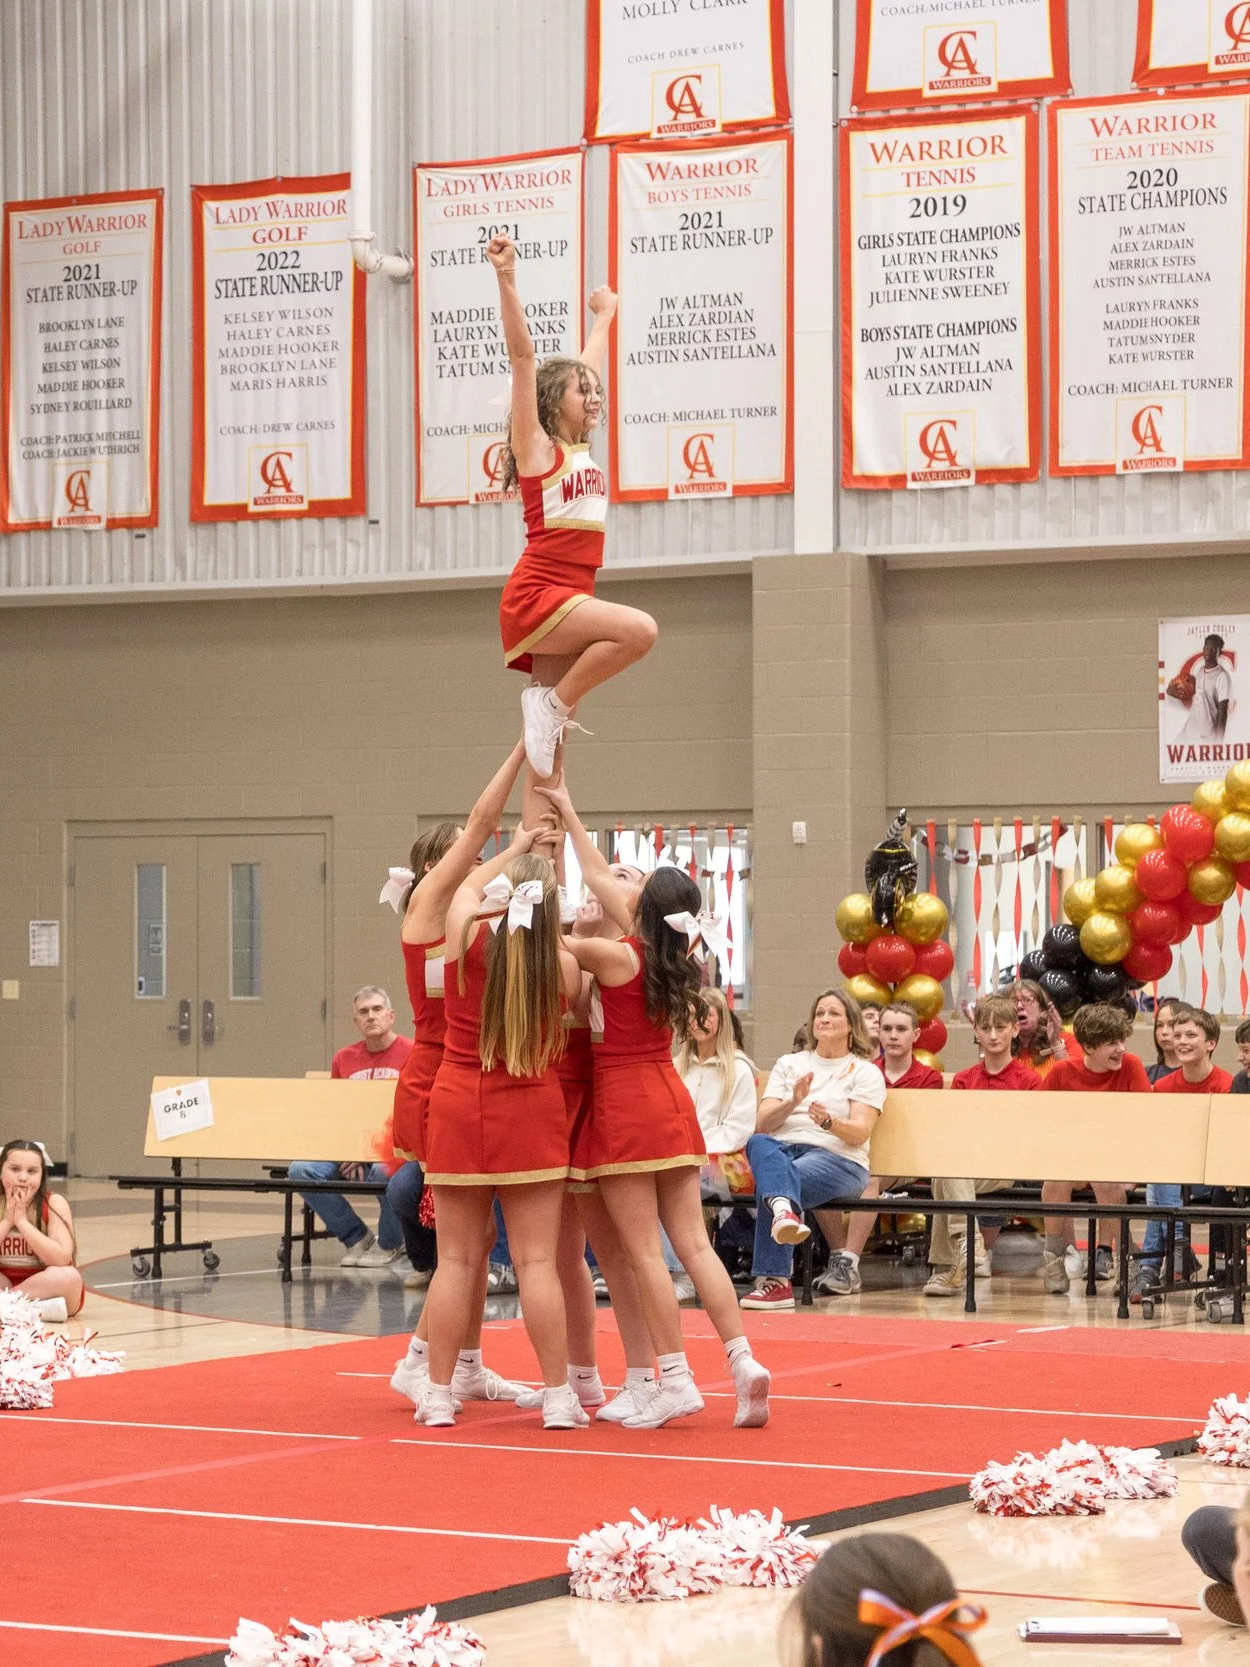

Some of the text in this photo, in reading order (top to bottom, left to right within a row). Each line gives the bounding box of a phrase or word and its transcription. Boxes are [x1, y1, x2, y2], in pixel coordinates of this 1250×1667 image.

[622, 0, 680, 20] MOLLY
[929, 0, 986, 12] MICHAEL
[670, 48, 699, 58] DREW
[704, 41, 744, 54] CARNES
[932, 77, 989, 89] WARRIORS
[660, 120, 714, 133] WARRIORS
[1089, 113, 1217, 138] WARRIOR
[868, 135, 1008, 165] WARRIOR
[1092, 140, 1214, 161] TEAM TENNIS
[645, 158, 759, 182] WARRIOR
[901, 167, 975, 187] TENNIS
[1127, 168, 1178, 190] 2020
[426, 169, 572, 197] LADY WARRIOR
[648, 184, 752, 204] BOYS TENNIS
[1078, 187, 1228, 214] STATE CHAMPIONS
[214, 199, 347, 224] LADY WARRIOR
[443, 196, 554, 218] GIRLS TENNIS
[909, 194, 966, 218] 2019
[18, 214, 147, 239] LADY WARRIOR
[679, 211, 723, 231] 2021
[1119, 222, 1186, 238] JW ALTMAN
[252, 226, 308, 244] GOLF
[630, 227, 773, 254] STATE RUNNER-UP
[858, 223, 1021, 250] GIRLS STATE CHAMPIONS
[63, 241, 101, 255] GOLF
[1110, 238, 1194, 254] ALEX ZARDAIN
[256, 251, 301, 271] 2022
[430, 247, 475, 267] STATE
[882, 246, 998, 267] LAURYN FRANKS
[1109, 255, 1196, 271] MERRICK ESTES
[63, 264, 101, 282] 2021
[885, 265, 995, 285] KATE WURSTER
[1093, 271, 1211, 289] AUSTIN SANTELLANA
[26, 280, 137, 303] STATE RUNNER-UP
[214, 271, 342, 299] STATE RUNNER-UP
[659, 292, 744, 313] JW ALTMAN
[868, 282, 1010, 308] JULIENNE SWEENEY
[431, 301, 569, 325] MADDIE OKER
[1105, 298, 1199, 314] LAURYN FRANKS
[39, 316, 124, 333] BROOKLYN LANE
[224, 307, 334, 325] KELSEY WILSON
[649, 309, 754, 330] ALEX ZARDIAN
[1103, 315, 1200, 331] MADDIE HOOKER
[227, 324, 331, 341] HALEY CARNES
[433, 325, 499, 343] LAURYN
[647, 327, 756, 347] MERRICK ESTES
[861, 317, 1017, 343] BOYS STATE CHAMPIONS
[44, 338, 119, 353] HALEY CARNES
[217, 340, 340, 358] MADDIE HOOKER
[1108, 333, 1196, 347] TATUM SNYDER
[438, 345, 479, 360] KATE
[626, 343, 777, 366] AUSTIN SANTELLANA
[895, 342, 981, 362] JW ALTMAN
[1108, 350, 1194, 365] KATE WURSTER
[42, 358, 121, 373] KELSEY WILSON
[220, 357, 337, 375] BROOKLYN LANE
[436, 361, 494, 379] TATUM
[865, 358, 1013, 380] AUSTIN SANTELLANA
[37, 378, 125, 393] MADDIE HOOKER
[230, 375, 327, 391] MARIS HARRIS
[886, 378, 992, 396] ALEX ZARDAIN
[1068, 378, 1234, 396] COACH: MICHAEL TURNER
[30, 402, 70, 414] SYDNEY
[624, 406, 777, 425] COACH: MICHAEL TURNER
[262, 423, 293, 433] DREW
[296, 420, 335, 431] CARNES
[427, 424, 470, 437] COACH:
[55, 432, 93, 444] PATRICK
[1125, 458, 1175, 469] WARRIORS
[914, 470, 969, 481] WARRIORS
[677, 483, 725, 493] WARRIORS
[164, 1097, 198, 1113] GRADE
